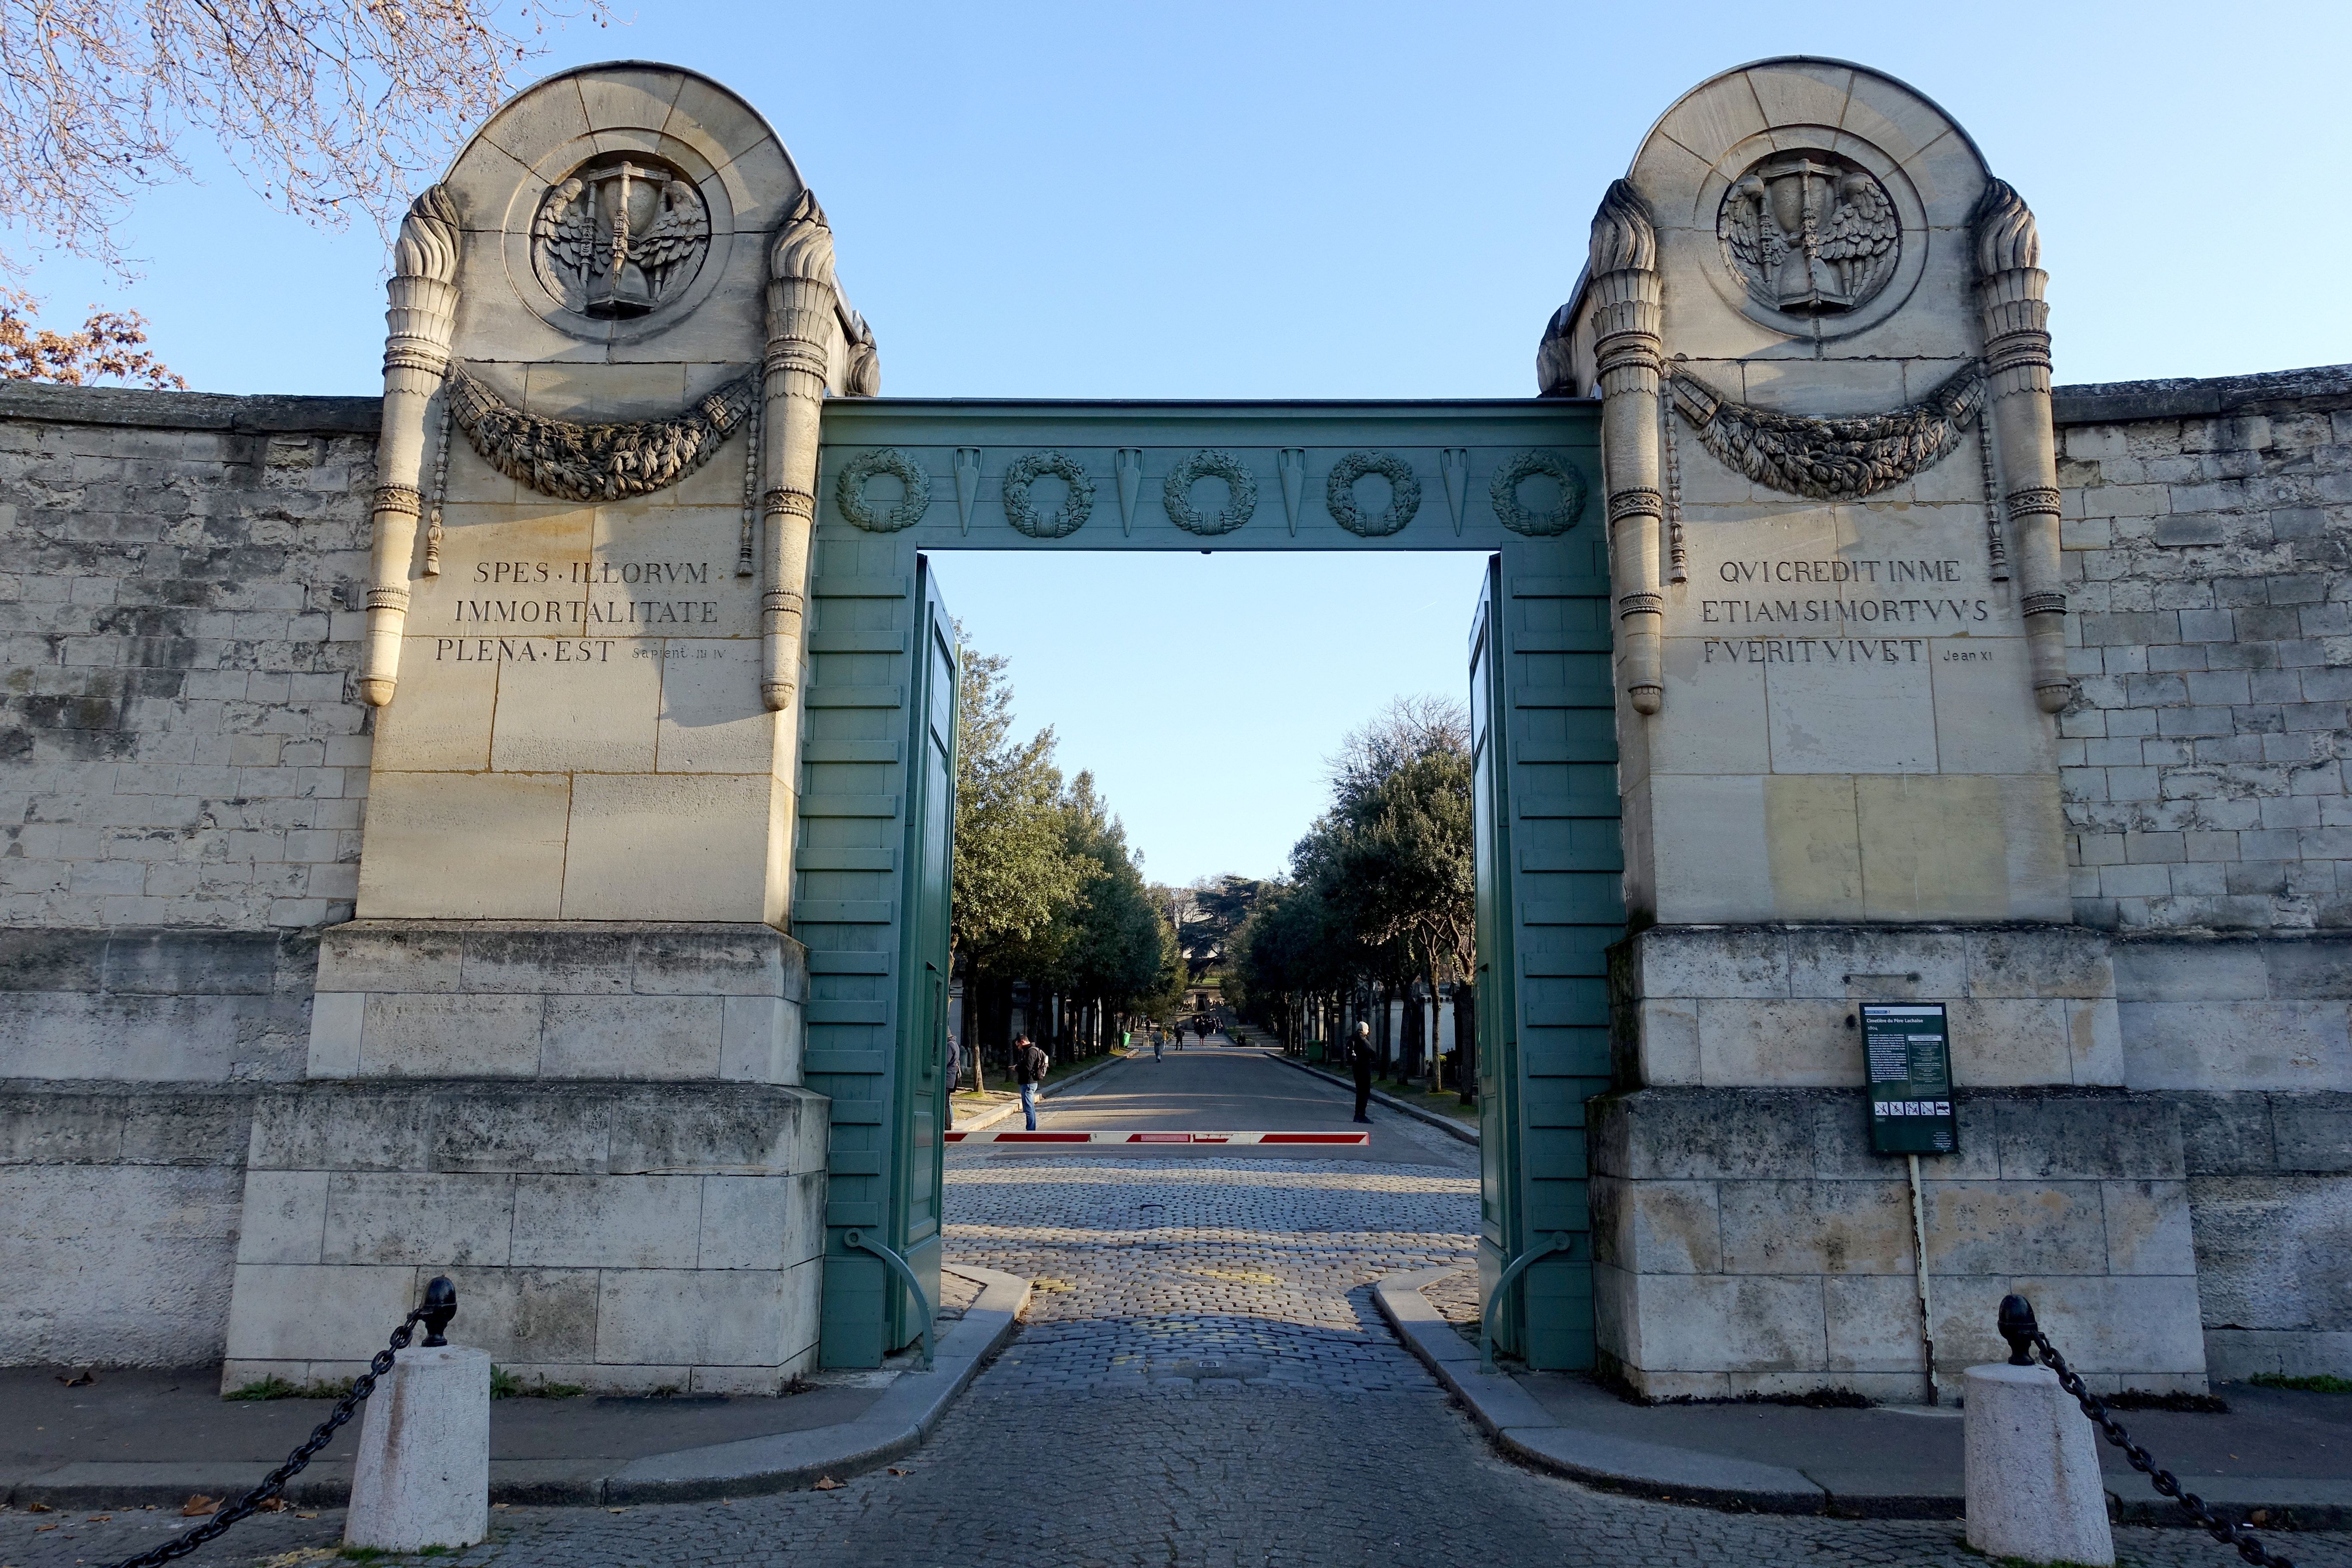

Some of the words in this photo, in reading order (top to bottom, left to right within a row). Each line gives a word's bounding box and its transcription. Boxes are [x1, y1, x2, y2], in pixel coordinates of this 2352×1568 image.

[474, 562, 548, 583] SPES
[571, 563, 708, 584] ILLORVM
[455, 601, 718, 623] IMMORTALITATE
[435, 639, 537, 662] PLENA
[554, 641, 615, 662] EST
[1943, 650, 1976, 661] Jean
[1980, 651, 1992, 661] XI
